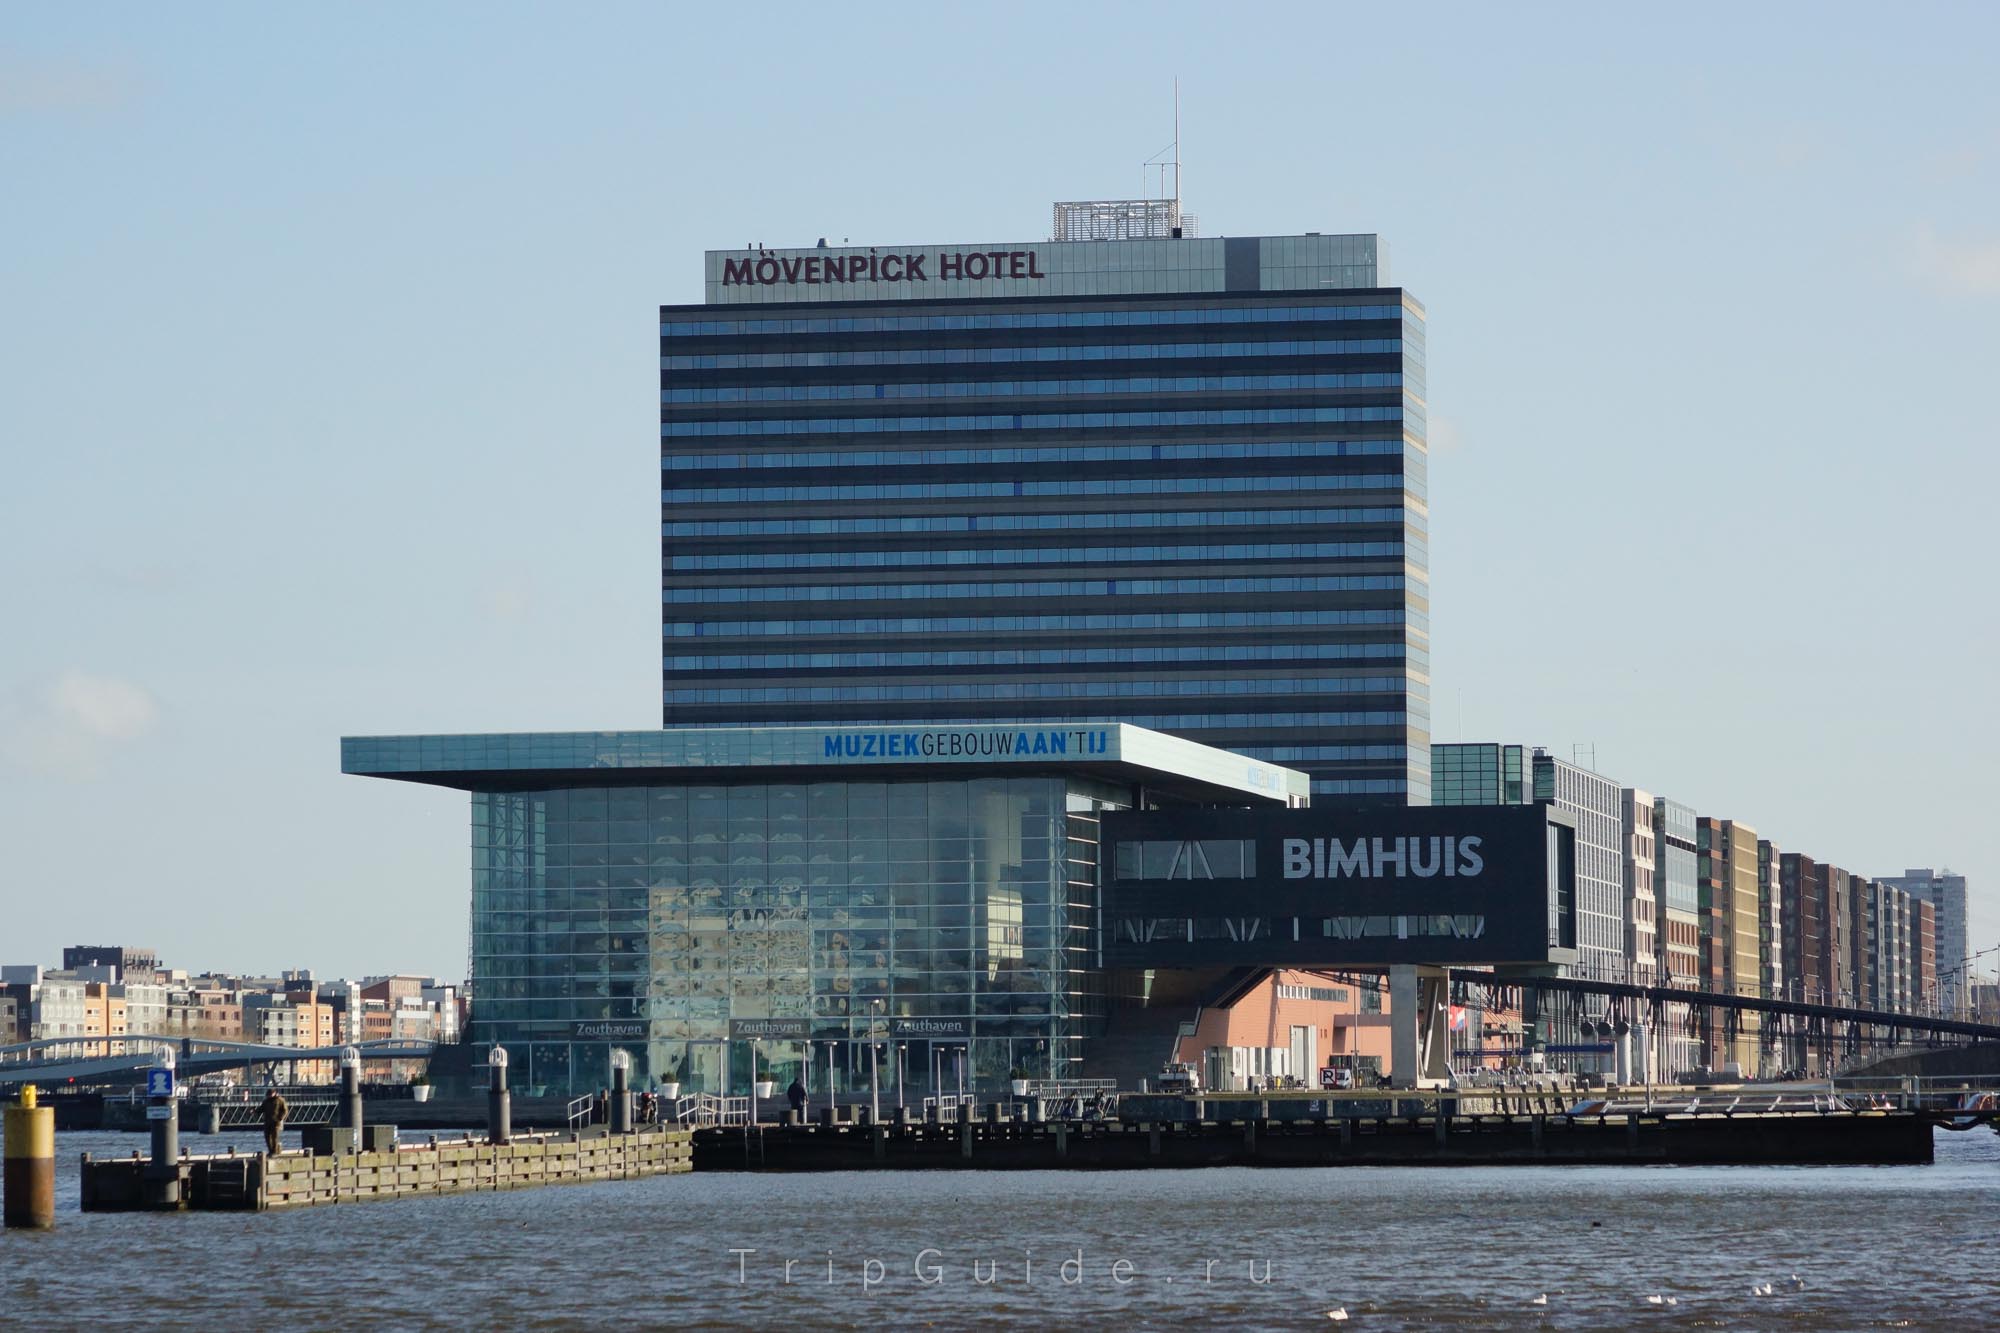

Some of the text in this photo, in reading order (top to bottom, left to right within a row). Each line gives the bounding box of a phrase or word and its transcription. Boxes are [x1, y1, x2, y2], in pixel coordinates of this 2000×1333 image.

[722, 250, 1045, 286] MÖVENPICK HOTEL
[1283, 836, 1484, 879] BIMHUIS
[576, 1022, 643, 1036] Zouthaven
[736, 1021, 801, 1034] Zouthaven
[896, 1019, 962, 1032] Zouthaven
